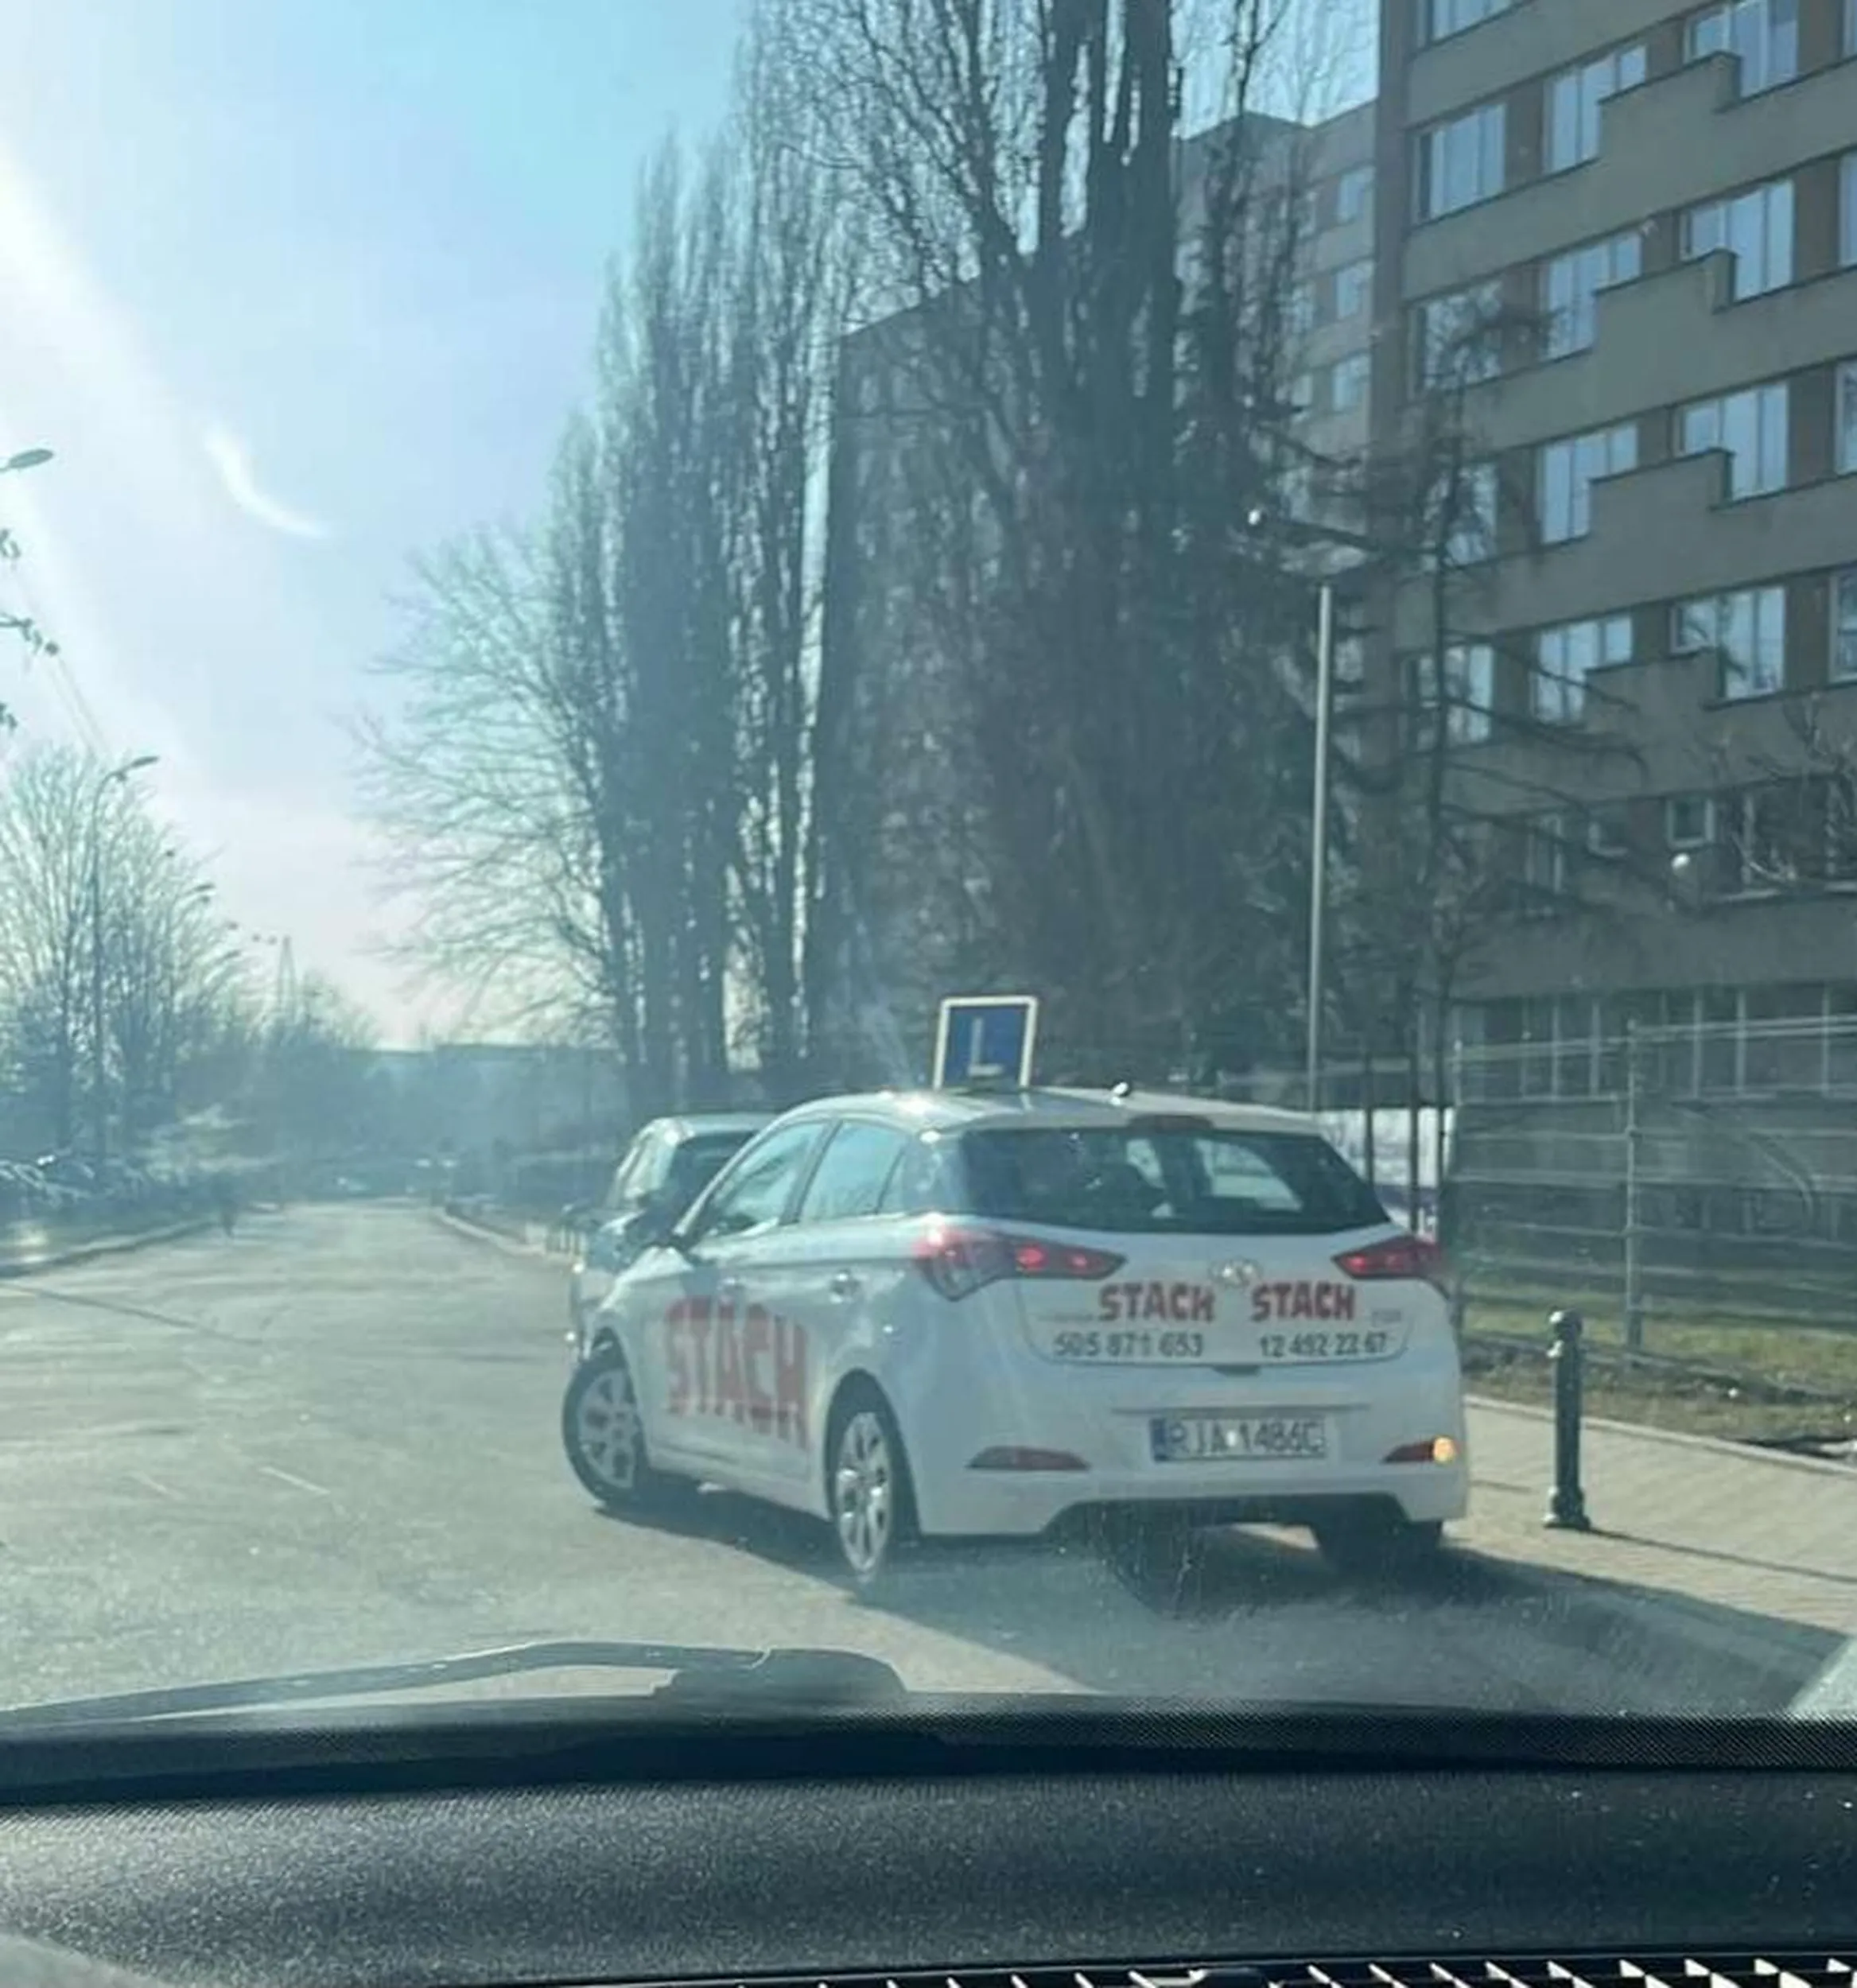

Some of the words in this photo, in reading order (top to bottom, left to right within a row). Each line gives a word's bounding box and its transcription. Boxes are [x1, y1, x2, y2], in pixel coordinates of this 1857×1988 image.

[968, 1017, 1004, 1077] L
[1098, 1280, 1216, 1323] STACH
[1251, 1280, 1356, 1322] STACH
[664, 1295, 811, 1452] STACH
